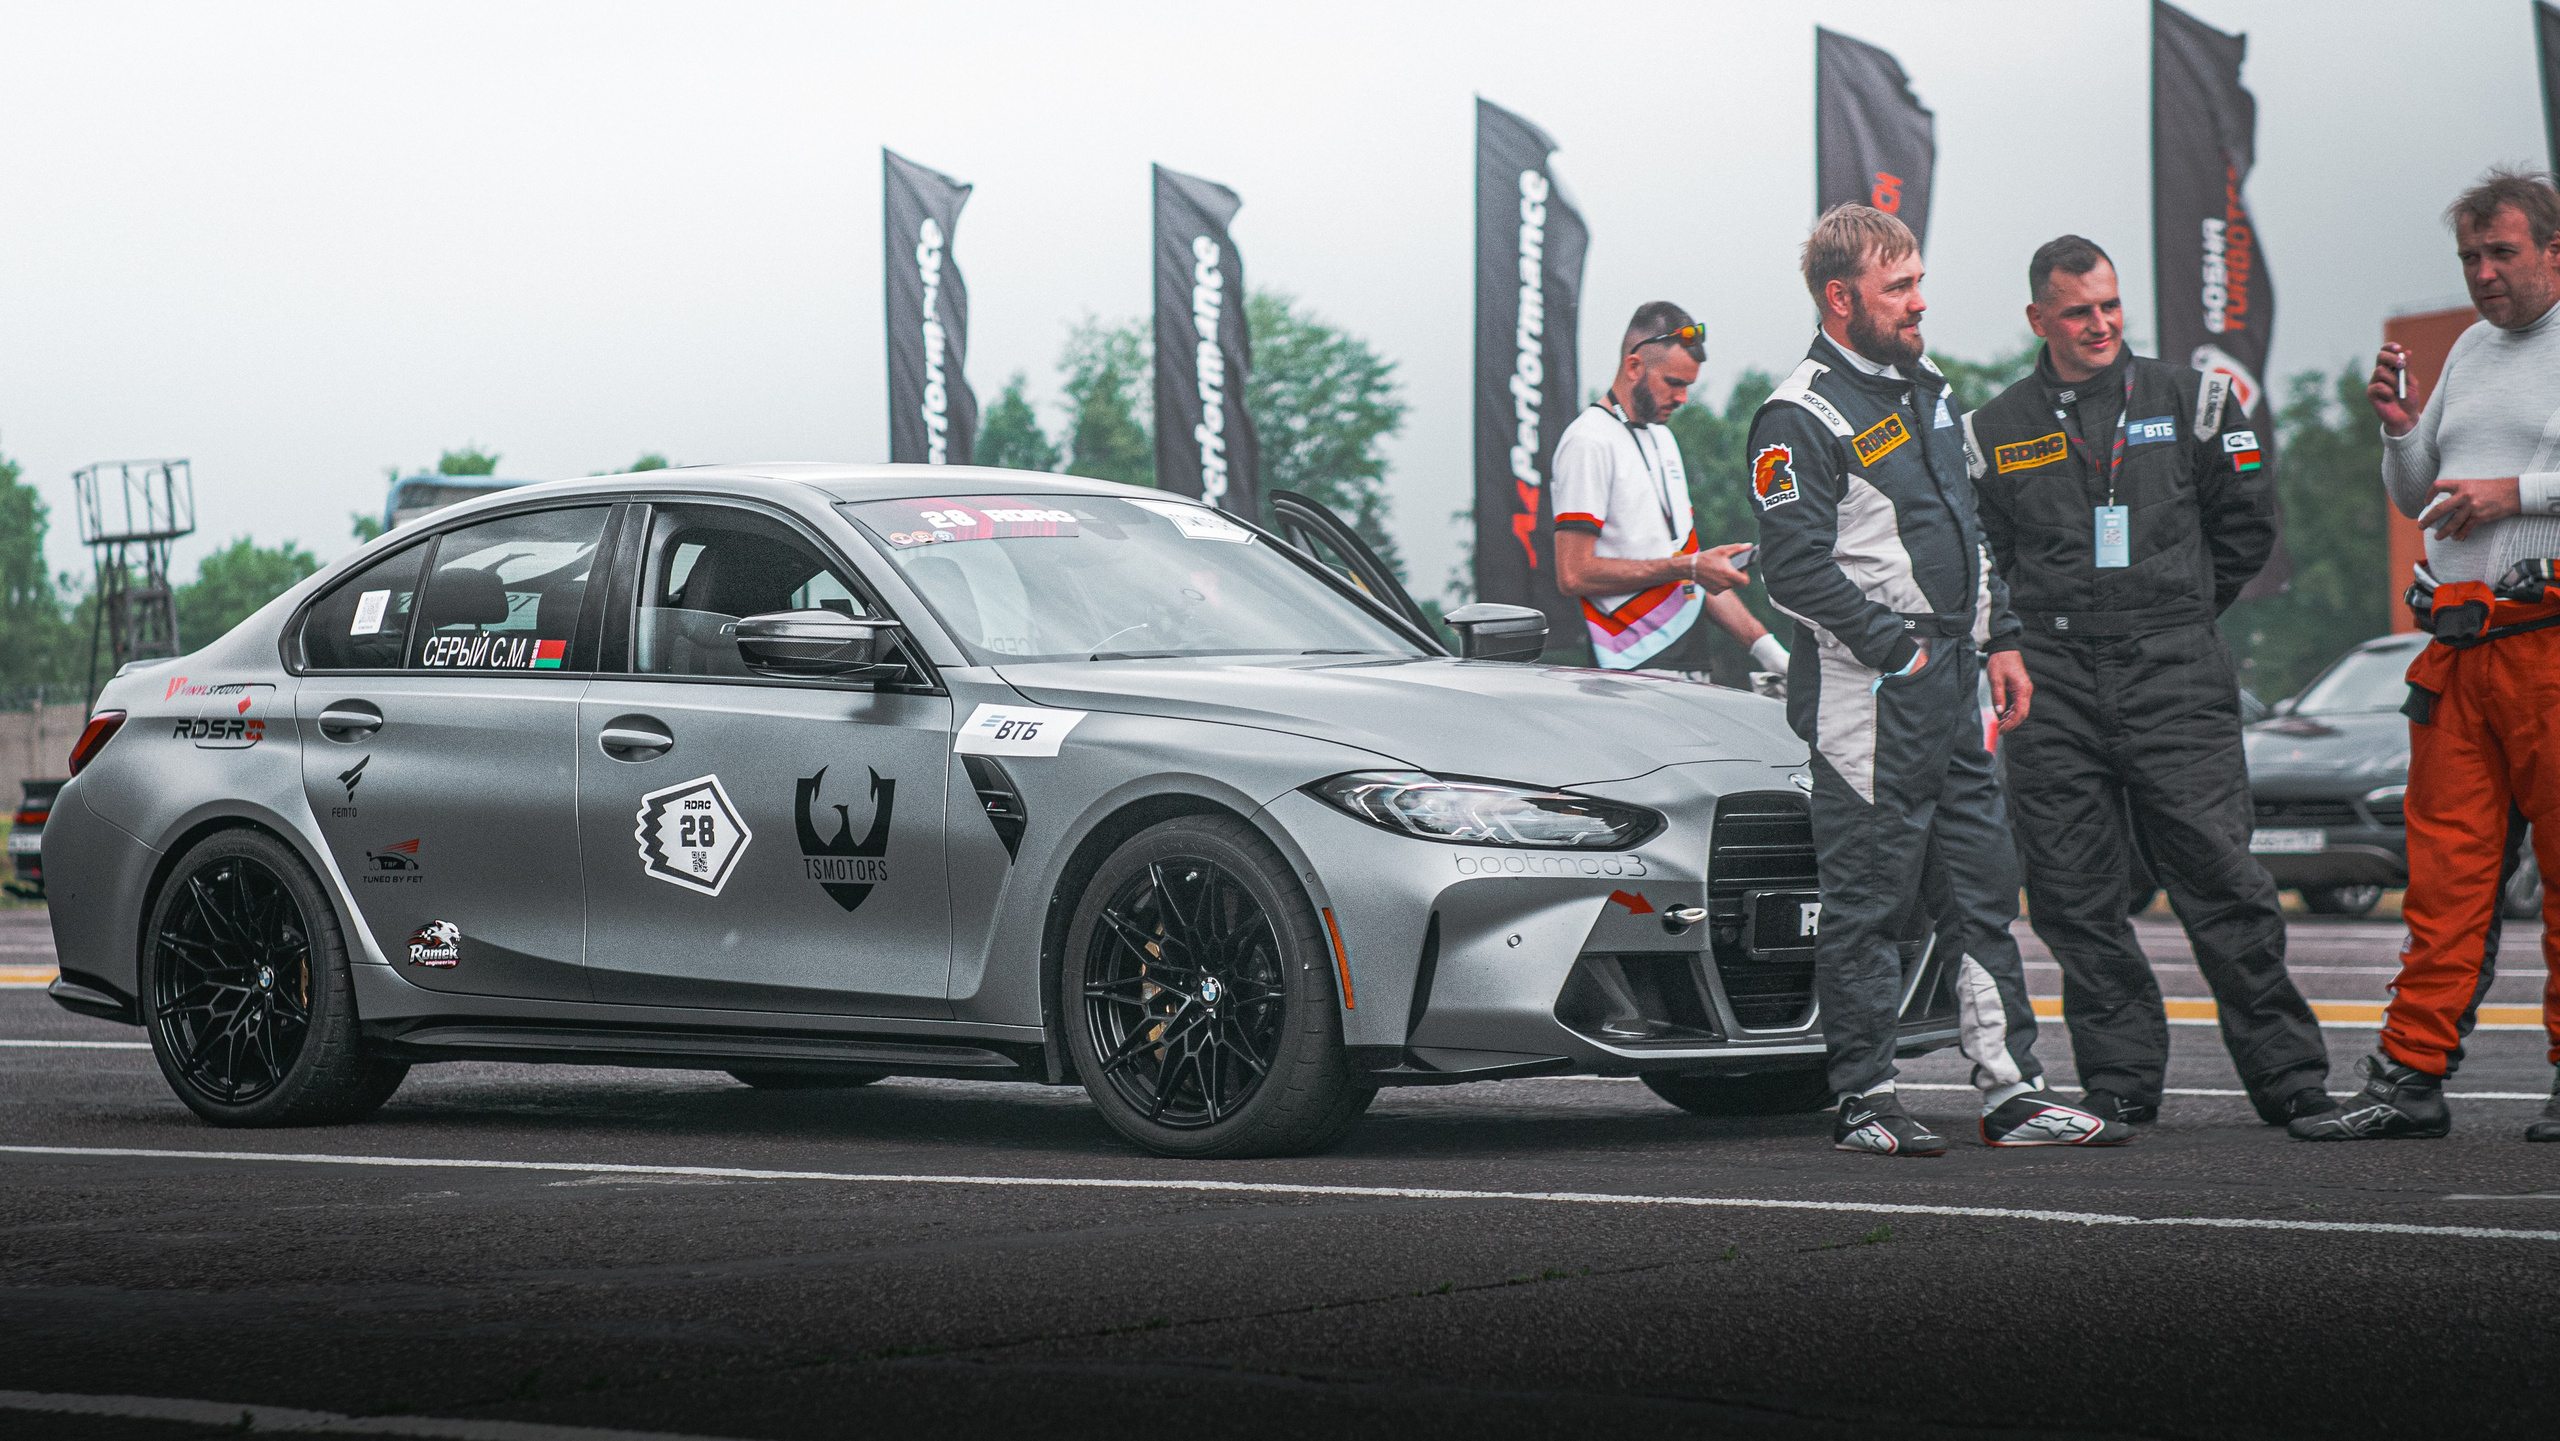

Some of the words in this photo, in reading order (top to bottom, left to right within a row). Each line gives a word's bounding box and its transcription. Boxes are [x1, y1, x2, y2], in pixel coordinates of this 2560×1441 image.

[1854, 418, 1903, 458] RDRC
[2143, 421, 2174, 438] ВТБ
[1998, 435, 2064, 466] RDRC
[1764, 490, 1798, 509] RDRC
[919, 509, 978, 529] 28
[979, 509, 1077, 523] RDRC
[422, 630, 491, 667] СЕРЫЙ
[491, 637, 527, 668] С.М.
[994, 719, 1045, 741] ВТБ
[331, 806, 358, 818] FEMTO
[684, 800, 711, 810] RDRC
[679, 815, 715, 848] 28
[803, 858, 888, 881] TSMOTORS
[1453, 852, 1648, 877] bootmod3
[363, 875, 391, 883] TUNED
[392, 875, 405, 883] BY
[406, 875, 423, 883] FET
